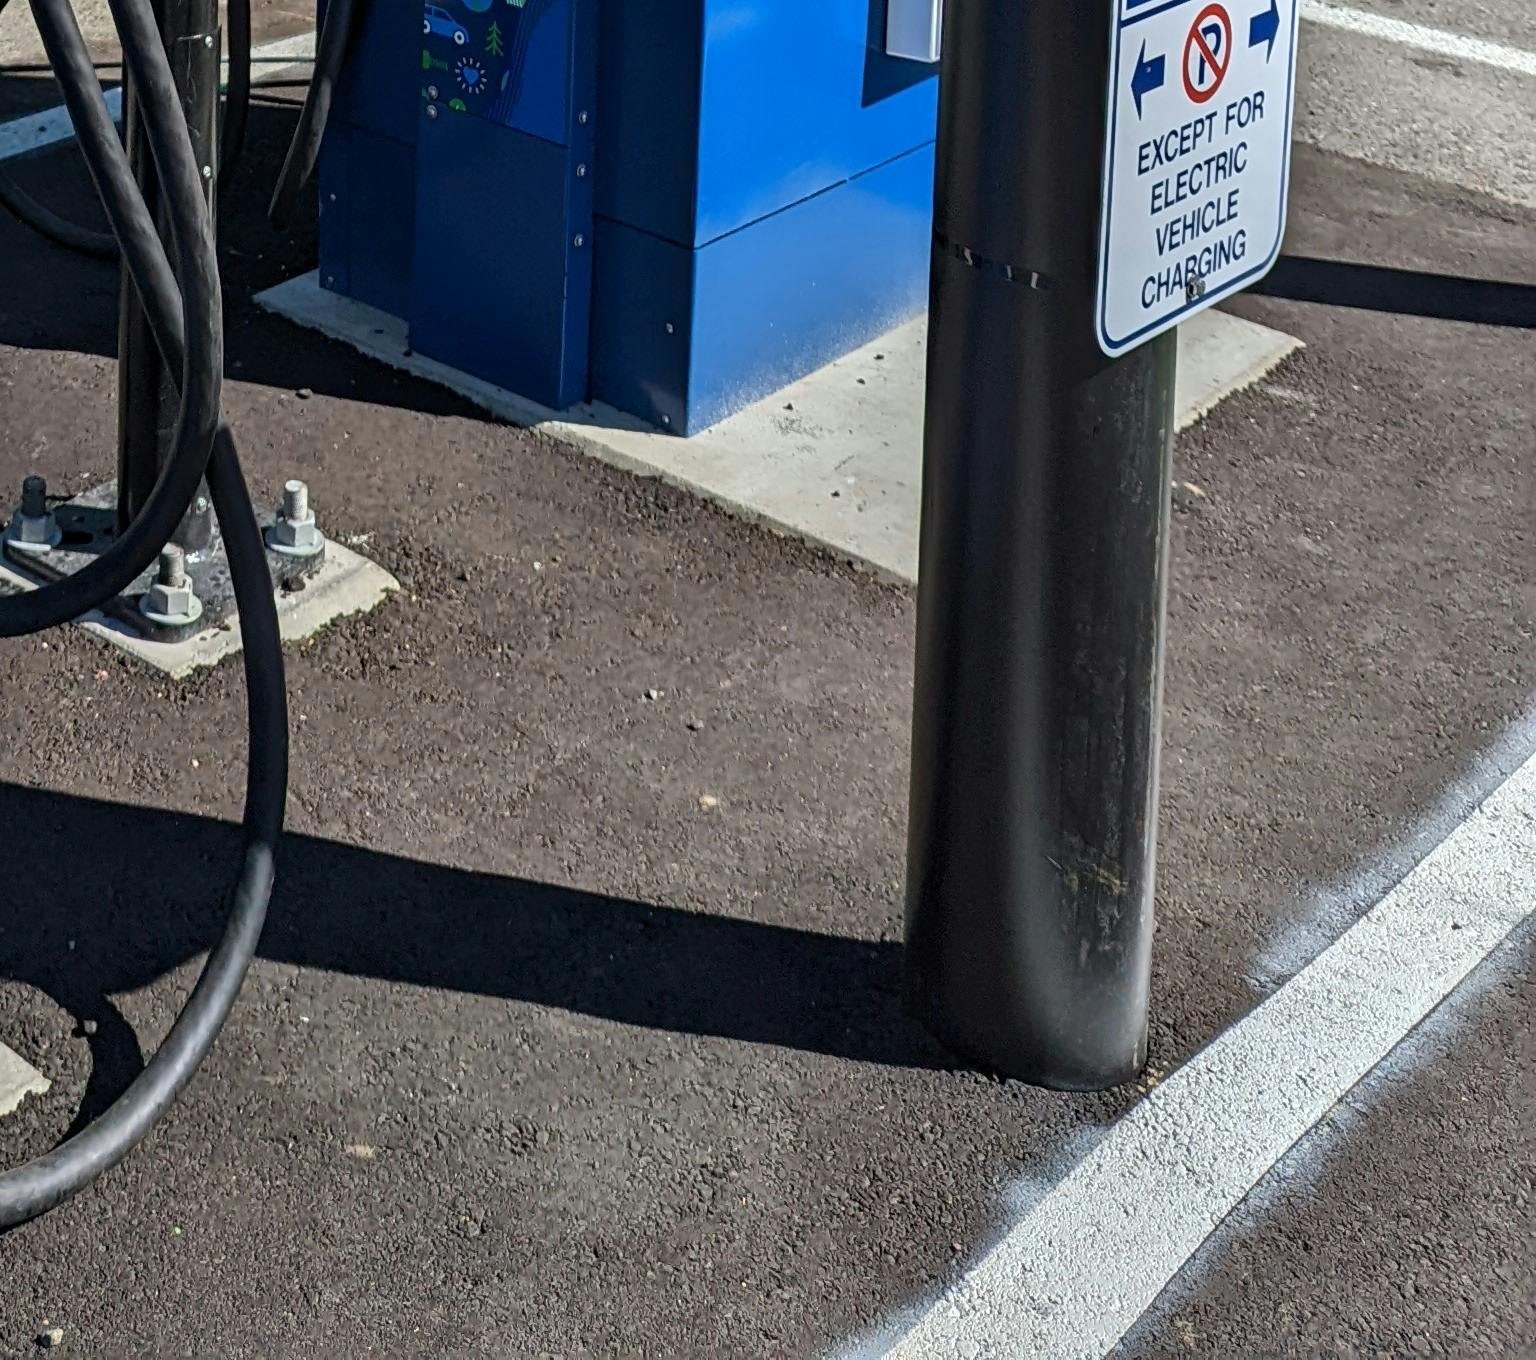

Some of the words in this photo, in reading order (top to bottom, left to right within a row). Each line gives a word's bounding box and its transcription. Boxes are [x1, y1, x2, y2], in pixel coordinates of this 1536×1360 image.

[1138, 111, 1217, 176] EXCEPT
[1225, 90, 1264, 135] FOR
[1151, 142, 1247, 215] ELECTRIC
[1156, 188, 1239, 256] VEHICLE
[1142, 229, 1246, 309] CHARGING
